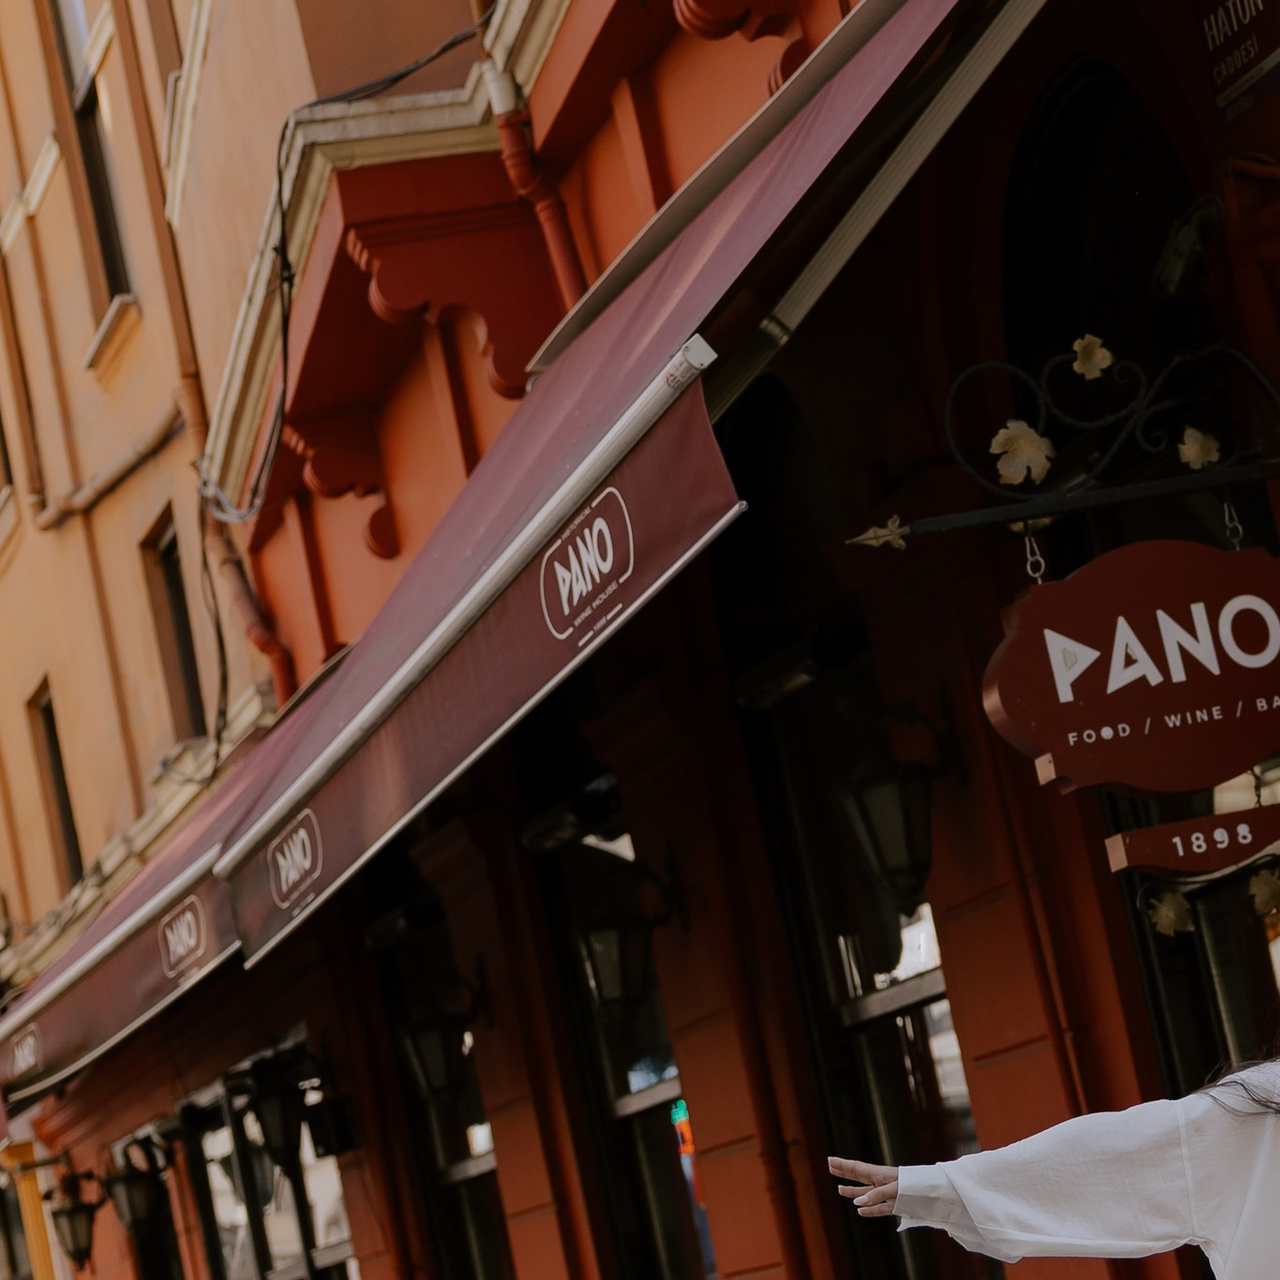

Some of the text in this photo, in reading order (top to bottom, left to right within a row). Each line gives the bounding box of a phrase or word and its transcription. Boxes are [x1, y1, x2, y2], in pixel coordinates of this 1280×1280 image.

[553, 517, 614, 616] PANO
[1067, 723, 1131, 747] FOOD
[1164, 705, 1224, 729] WINE
[1171, 823, 1253, 858] 1898
